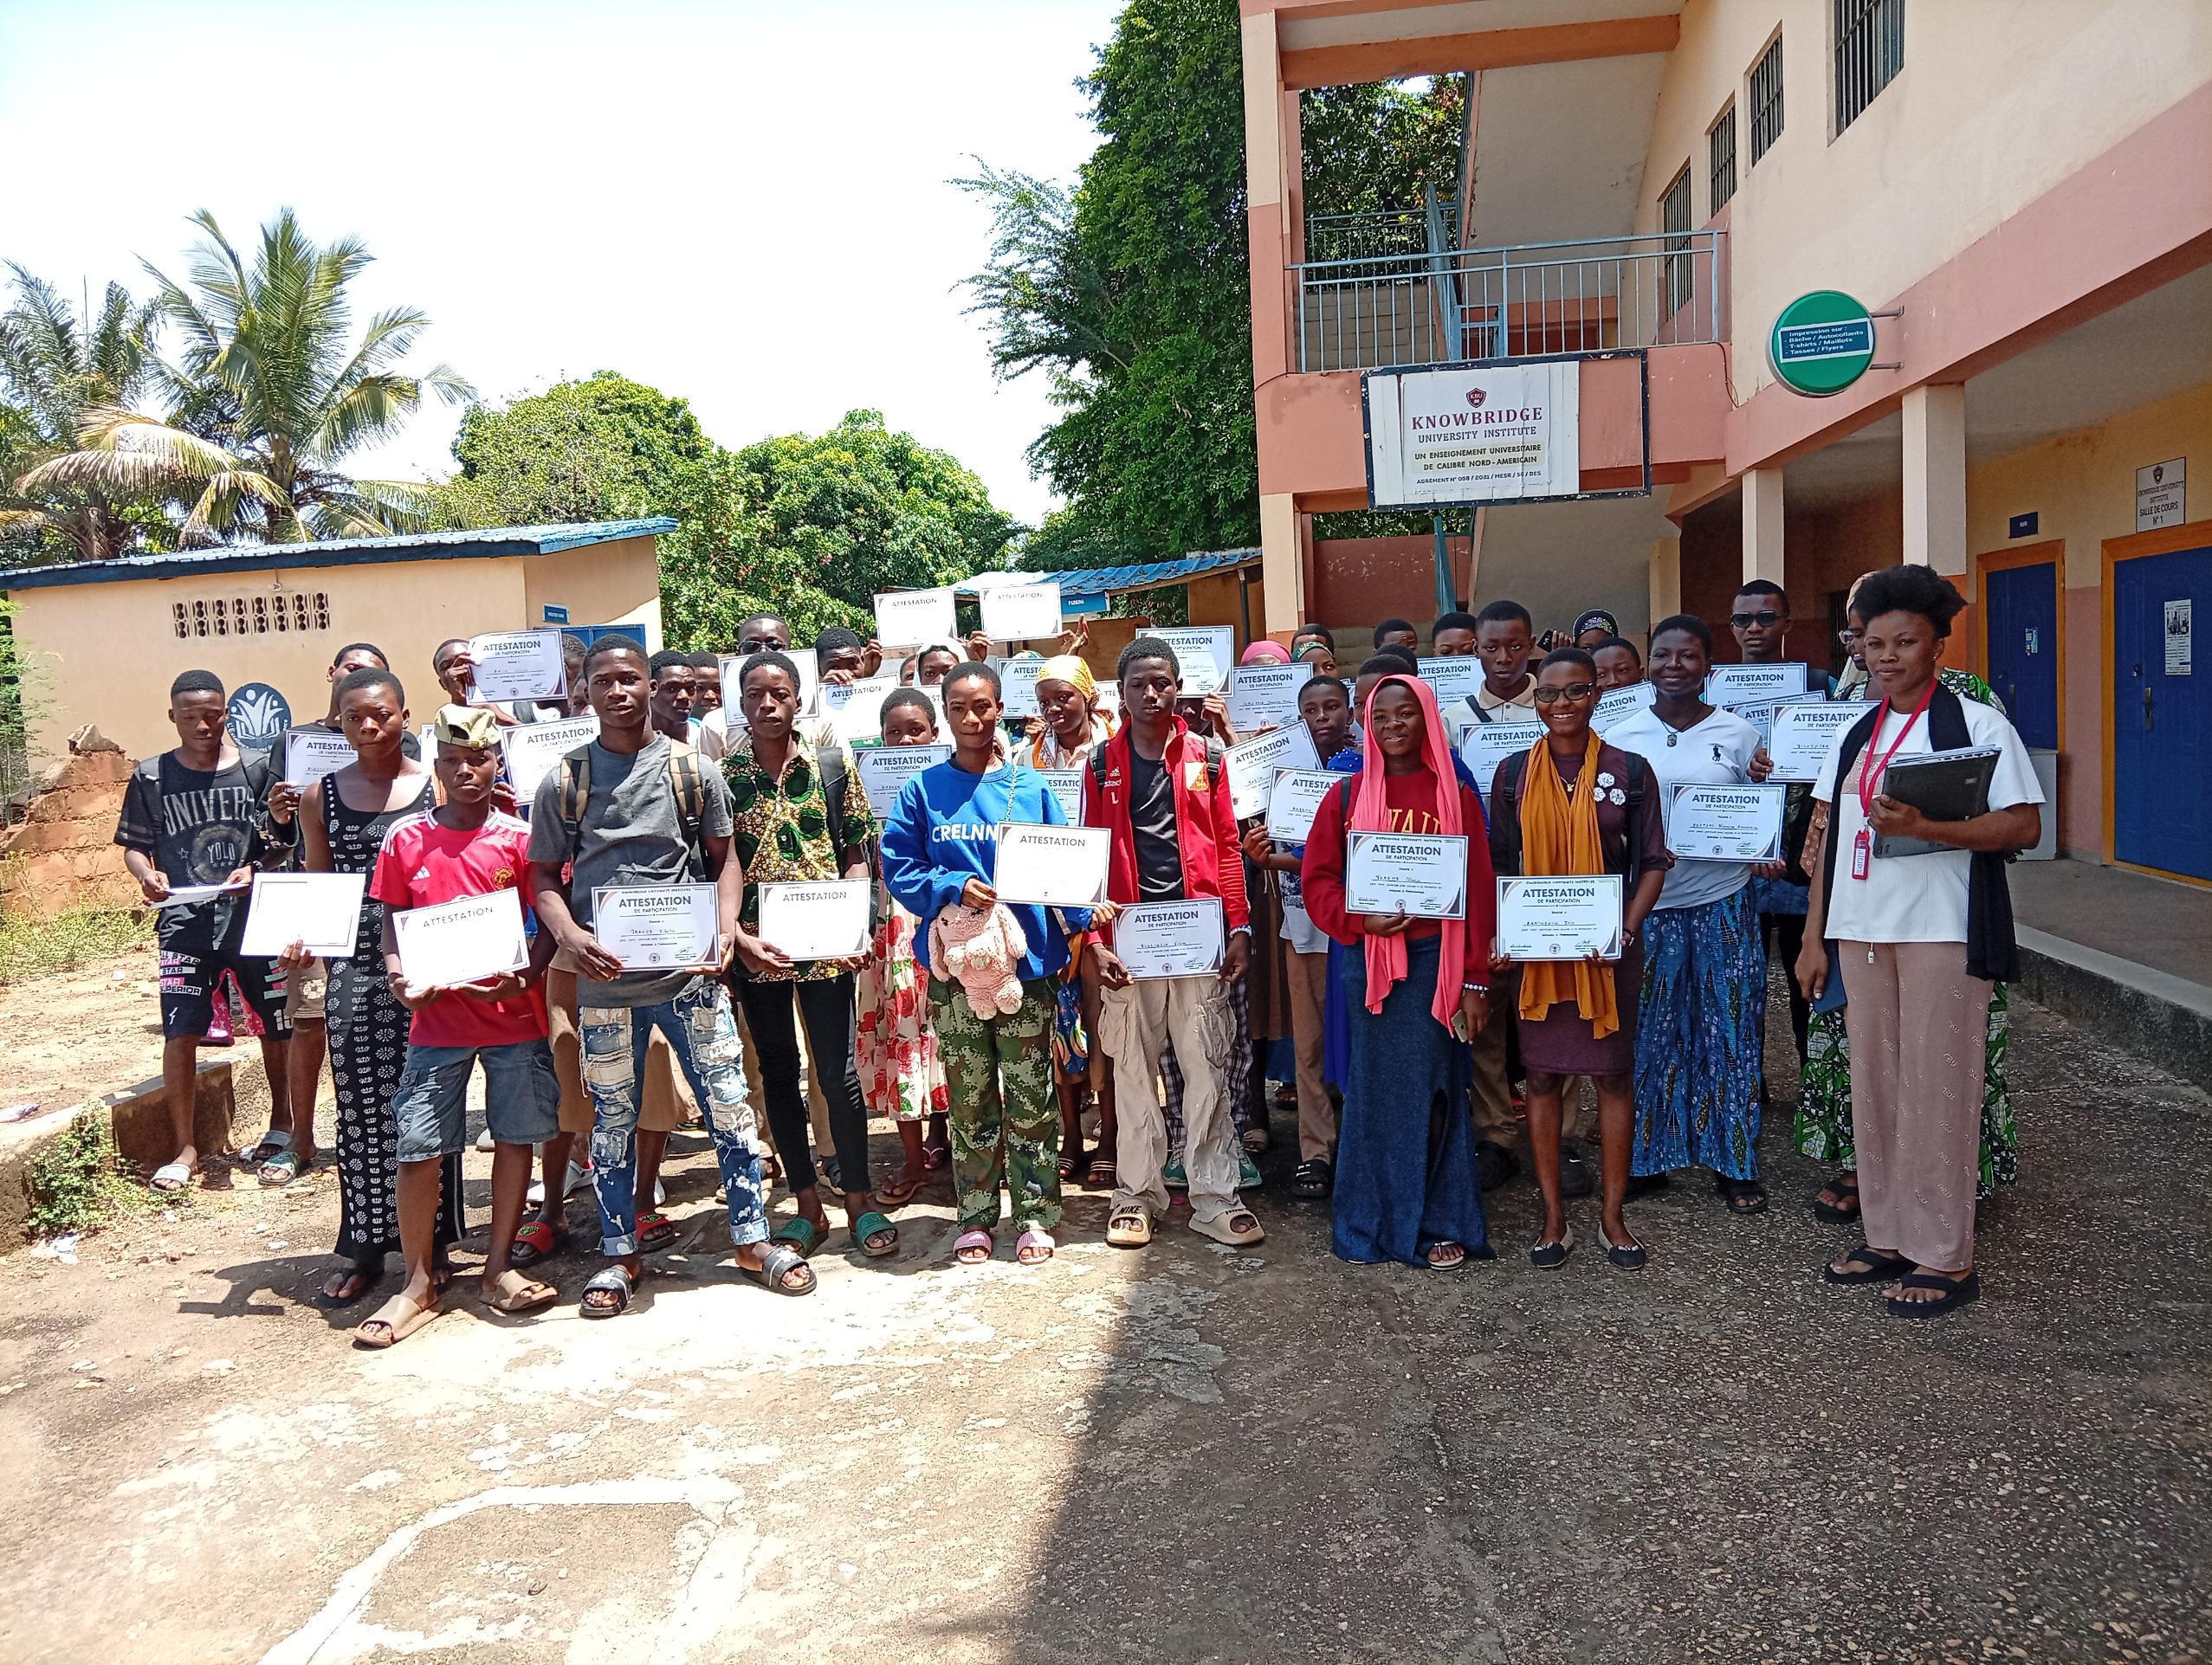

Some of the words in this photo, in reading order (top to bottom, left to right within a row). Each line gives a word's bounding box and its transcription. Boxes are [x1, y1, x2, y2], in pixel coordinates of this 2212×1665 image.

[1789, 328, 1830, 337] Impression
[1818, 331, 1864, 339] Autocollants
[1412, 407, 1543, 429] KNOWBRIDGE
[1418, 430, 1478, 443] UNIVERSITY
[1484, 426, 1536, 438] INSTITUTE
[1430, 448, 1487, 459] ENSEIGNEMENT
[1490, 444, 1542, 455] UNIVERSITAIRE
[1437, 461, 1465, 469] CALIBRE
[2139, 507, 2154, 516] SALLE
[2154, 505, 2161, 513] DE
[2161, 501, 2178, 513] COURS
[483, 641, 541, 651] ATTESTATION
[1237, 674, 1293, 684] ATTESTATION
[1793, 713, 1858, 722] ATTESTATIO
[527, 727, 593, 744] ATTESTATION
[1481, 731, 1543, 741] ATTESTATION
[307, 742, 357, 751] ATTESTATI
[1236, 737, 1290, 764] ATTESTATION
[872, 756, 932, 766] ATTESTATION
[1291, 779, 1335, 789] ATTESTA
[1691, 794, 1760, 804] ATTESTATION
[1019, 836, 1085, 847] ATTESTATION
[208, 842, 236, 864] YOLO
[1372, 844, 1441, 855] ATTESTATION
[783, 892, 847, 901] ATTESTATION
[1523, 888, 1595, 898] ATTESTATION
[618, 896, 691, 907] ATTESTATION
[424, 907, 493, 927] ATTESTATION
[1135, 911, 1199, 923] ATTESTATION
[171, 952, 200, 965] STAR
[1118, 1205, 1142, 1214] NIKE
